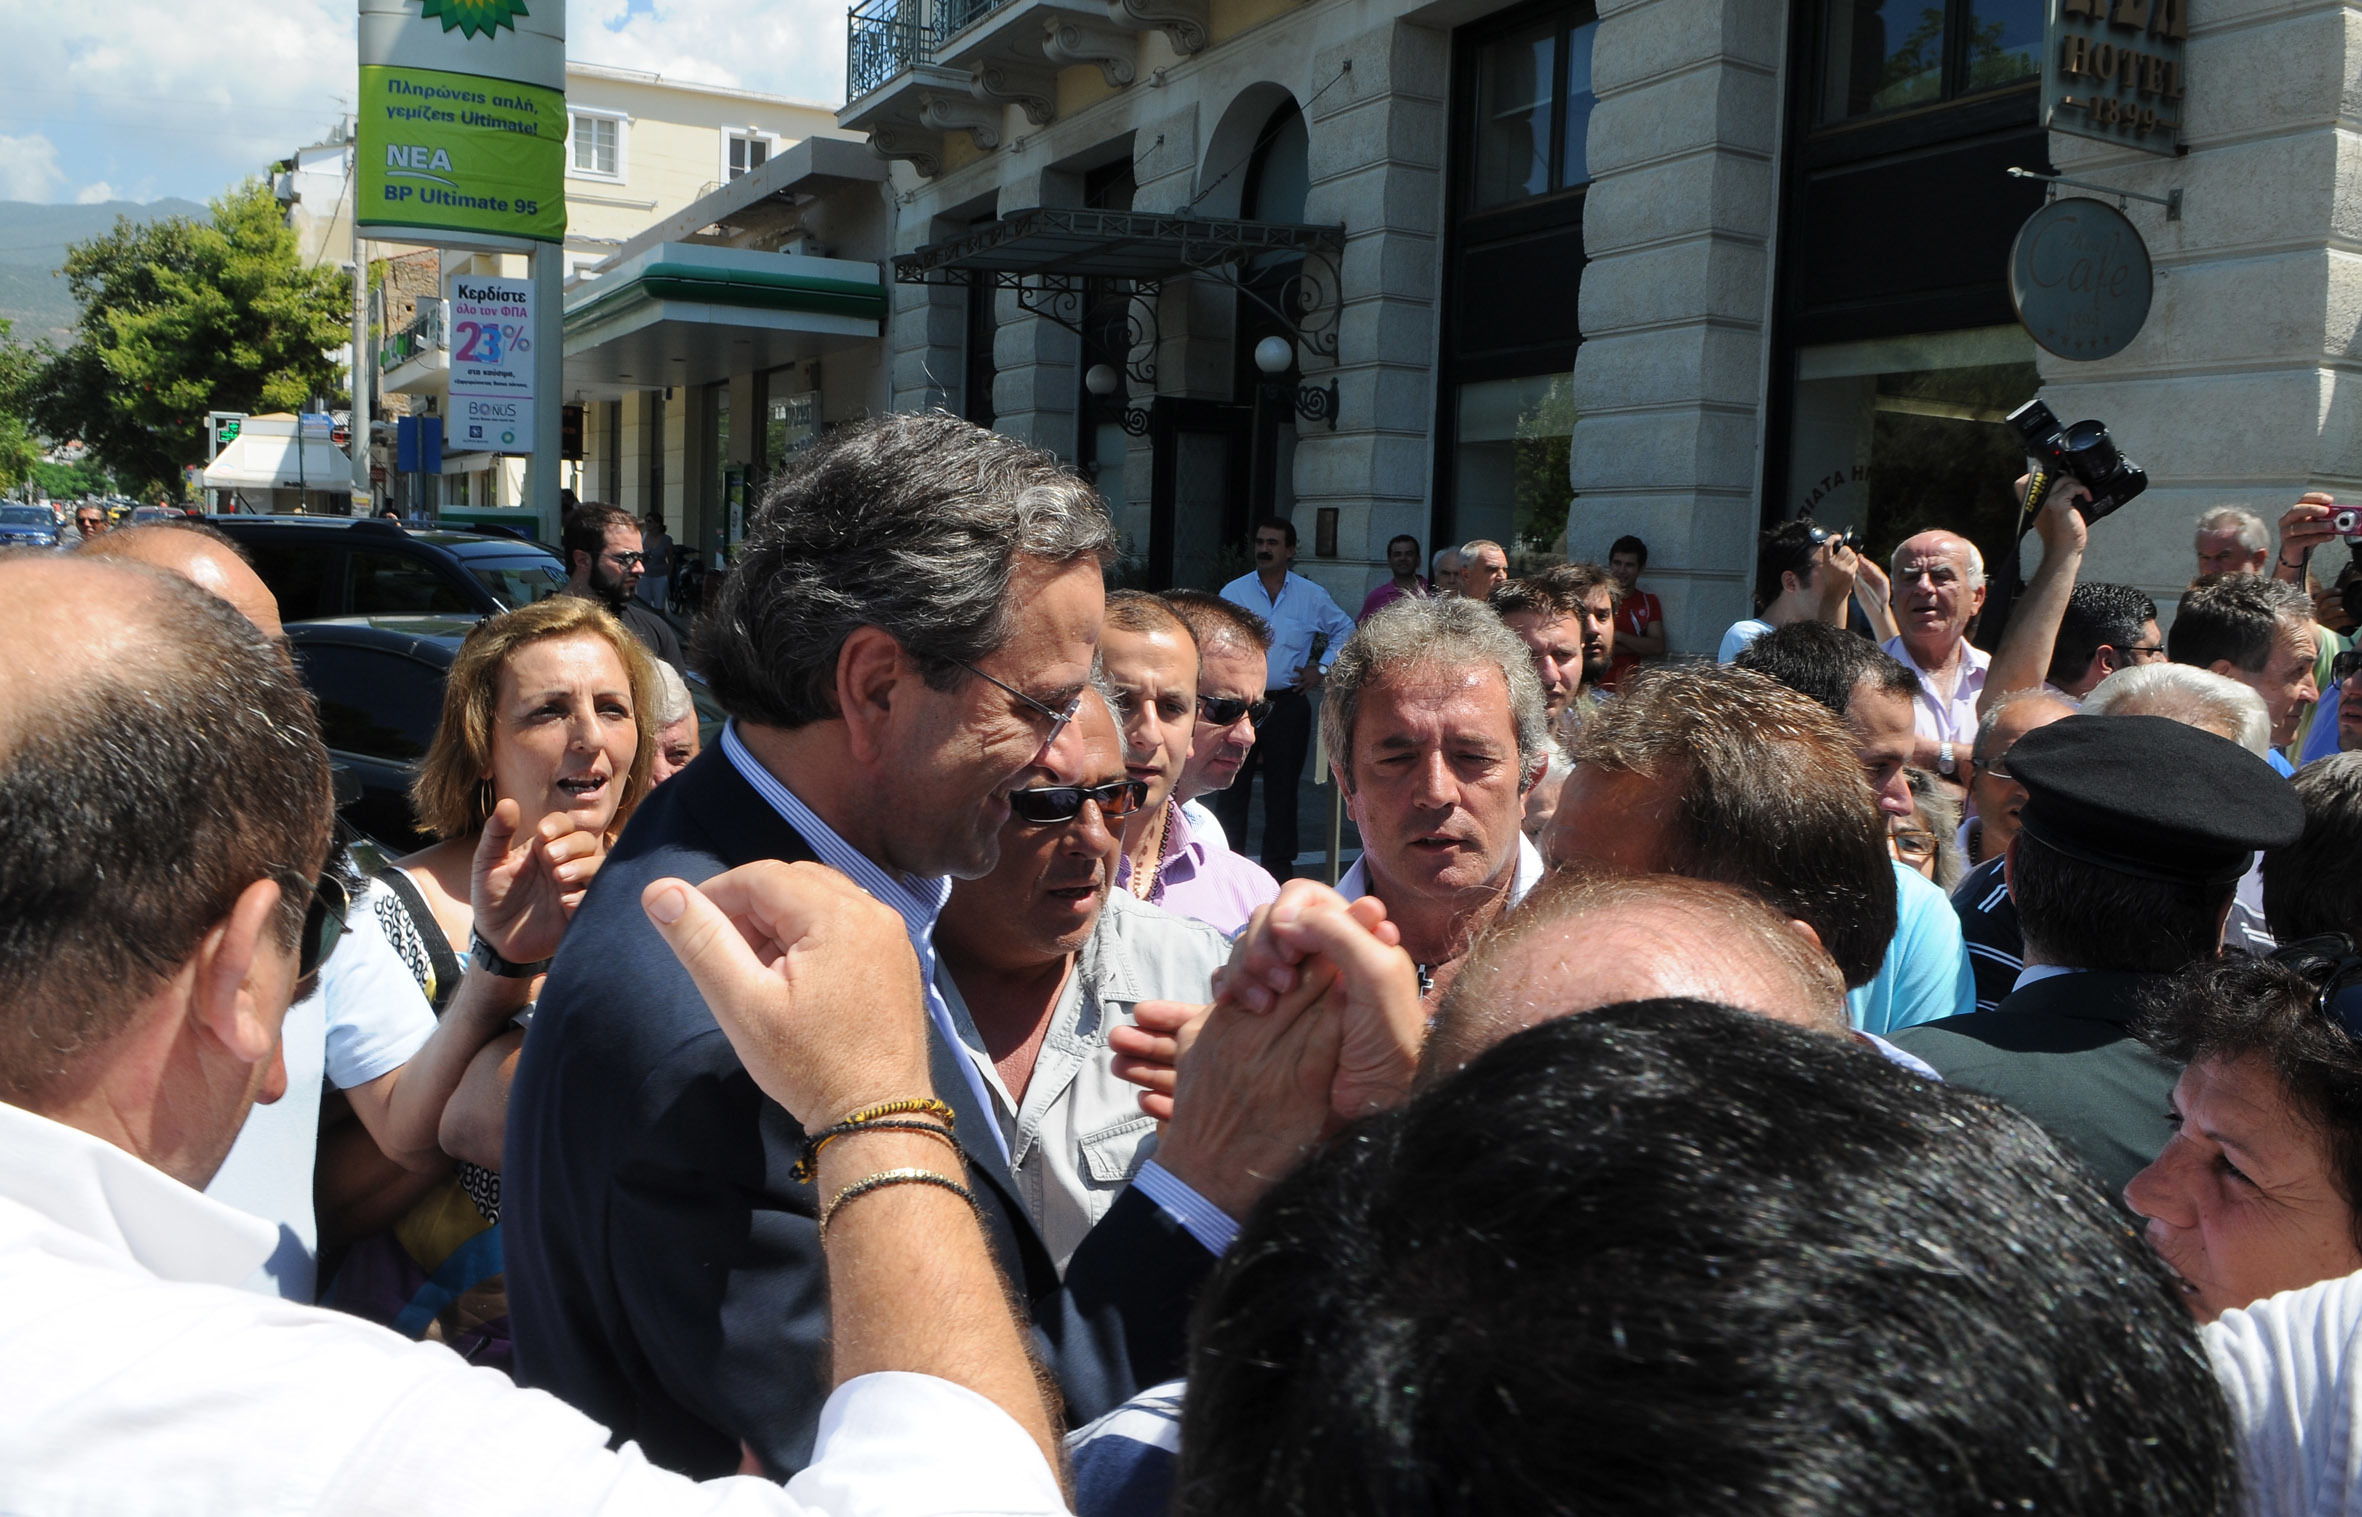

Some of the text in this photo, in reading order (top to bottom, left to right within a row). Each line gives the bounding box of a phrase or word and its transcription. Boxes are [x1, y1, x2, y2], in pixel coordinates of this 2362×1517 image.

[2062, 34, 2185, 100] HOTEL
[387, 79, 486, 105] Πληρώνεις
[386, 105, 538, 136] γεμίζεις Ultimate!
[2089, 95, 2156, 134] 1899
[384, 184, 538, 216] BP Ultimate 95
[458, 284, 526, 304] Κερδίστε
[456, 303, 528, 318] όλο τον ΦΠΑ
[469, 401, 517, 417] BONUS
[2025, 472, 2048, 513] Nikon
